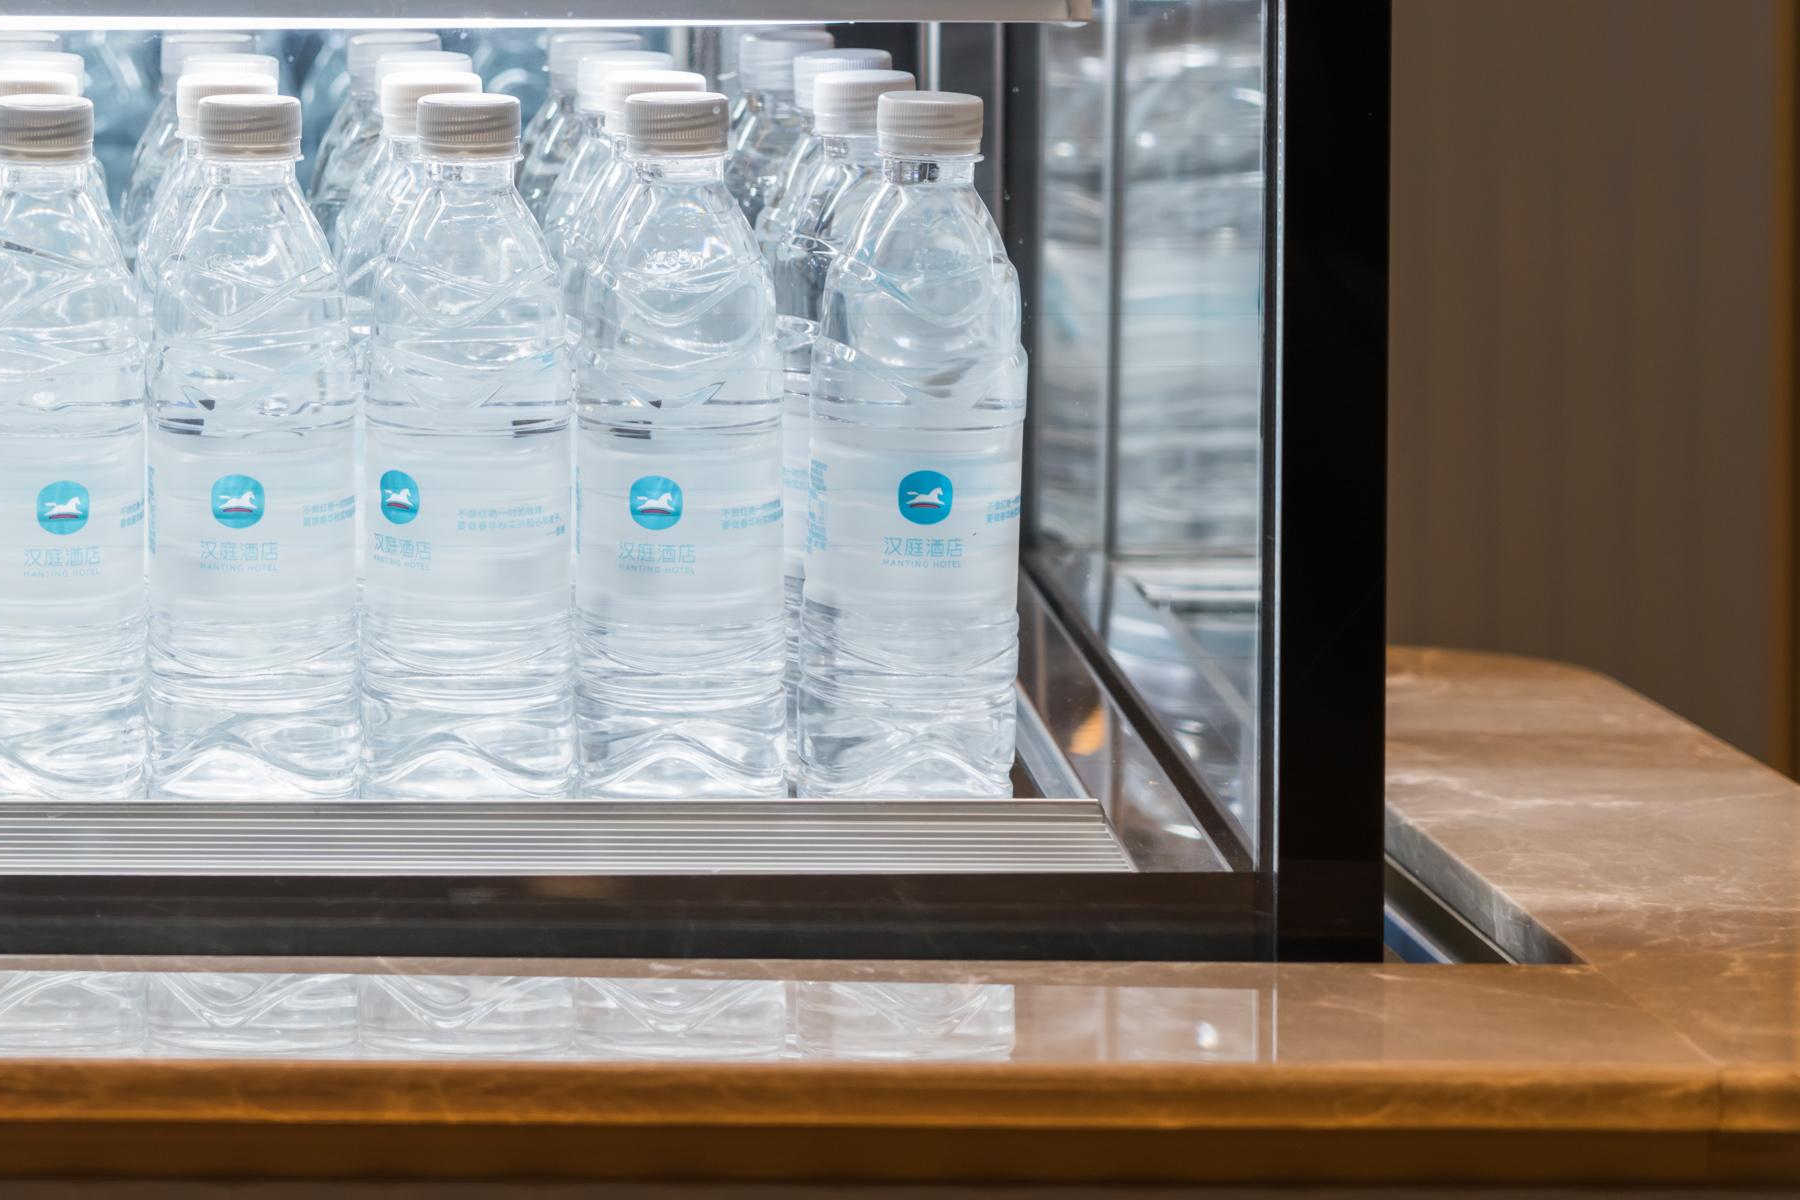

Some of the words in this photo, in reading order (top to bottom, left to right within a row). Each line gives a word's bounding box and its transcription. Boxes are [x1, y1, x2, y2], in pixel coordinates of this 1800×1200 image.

[200, 540, 279, 561] 汉庭酒店
[619, 542, 696, 563] 汉庭酒店
[883, 536, 963, 558] 汉庭酒店
[248, 563, 278, 571] HOTEL
[664, 566, 695, 574] HOTEL
[883, 559, 929, 568] HANTING
[933, 560, 961, 568] HOTEL
